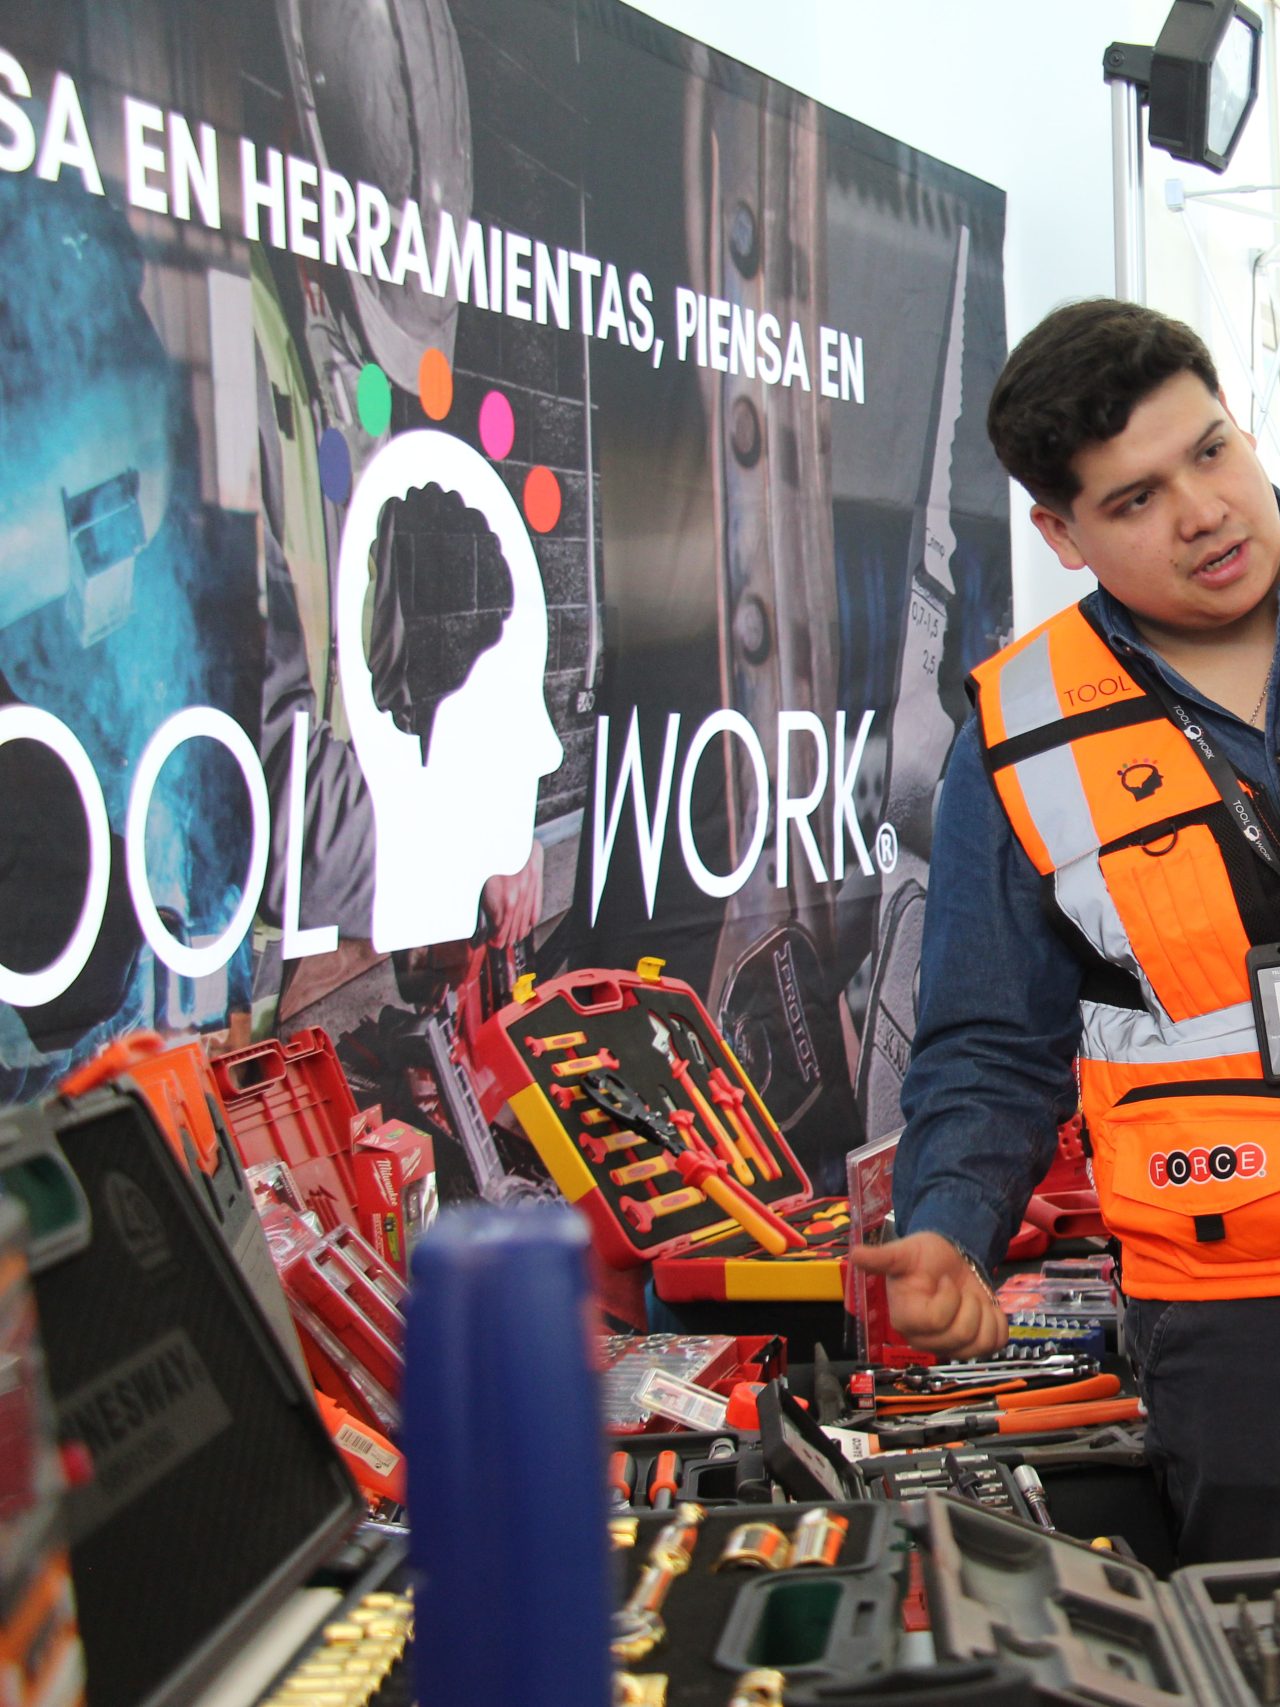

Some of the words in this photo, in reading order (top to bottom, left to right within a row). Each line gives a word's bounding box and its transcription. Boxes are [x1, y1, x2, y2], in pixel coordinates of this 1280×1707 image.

[123, 95, 221, 230] EN
[240, 136, 665, 369] HERRAMIENTAS,
[676, 286, 811, 392] PIENSA
[820, 326, 865, 405] EN
[1063, 675, 1132, 707] TOOL
[1173, 704, 1191, 726] TOOL
[1197, 737, 1214, 760] WORK
[1232, 800, 1250, 826] TOOL
[1255, 840, 1273, 862] WORK
[1152, 1148, 1258, 1183] FORCE
